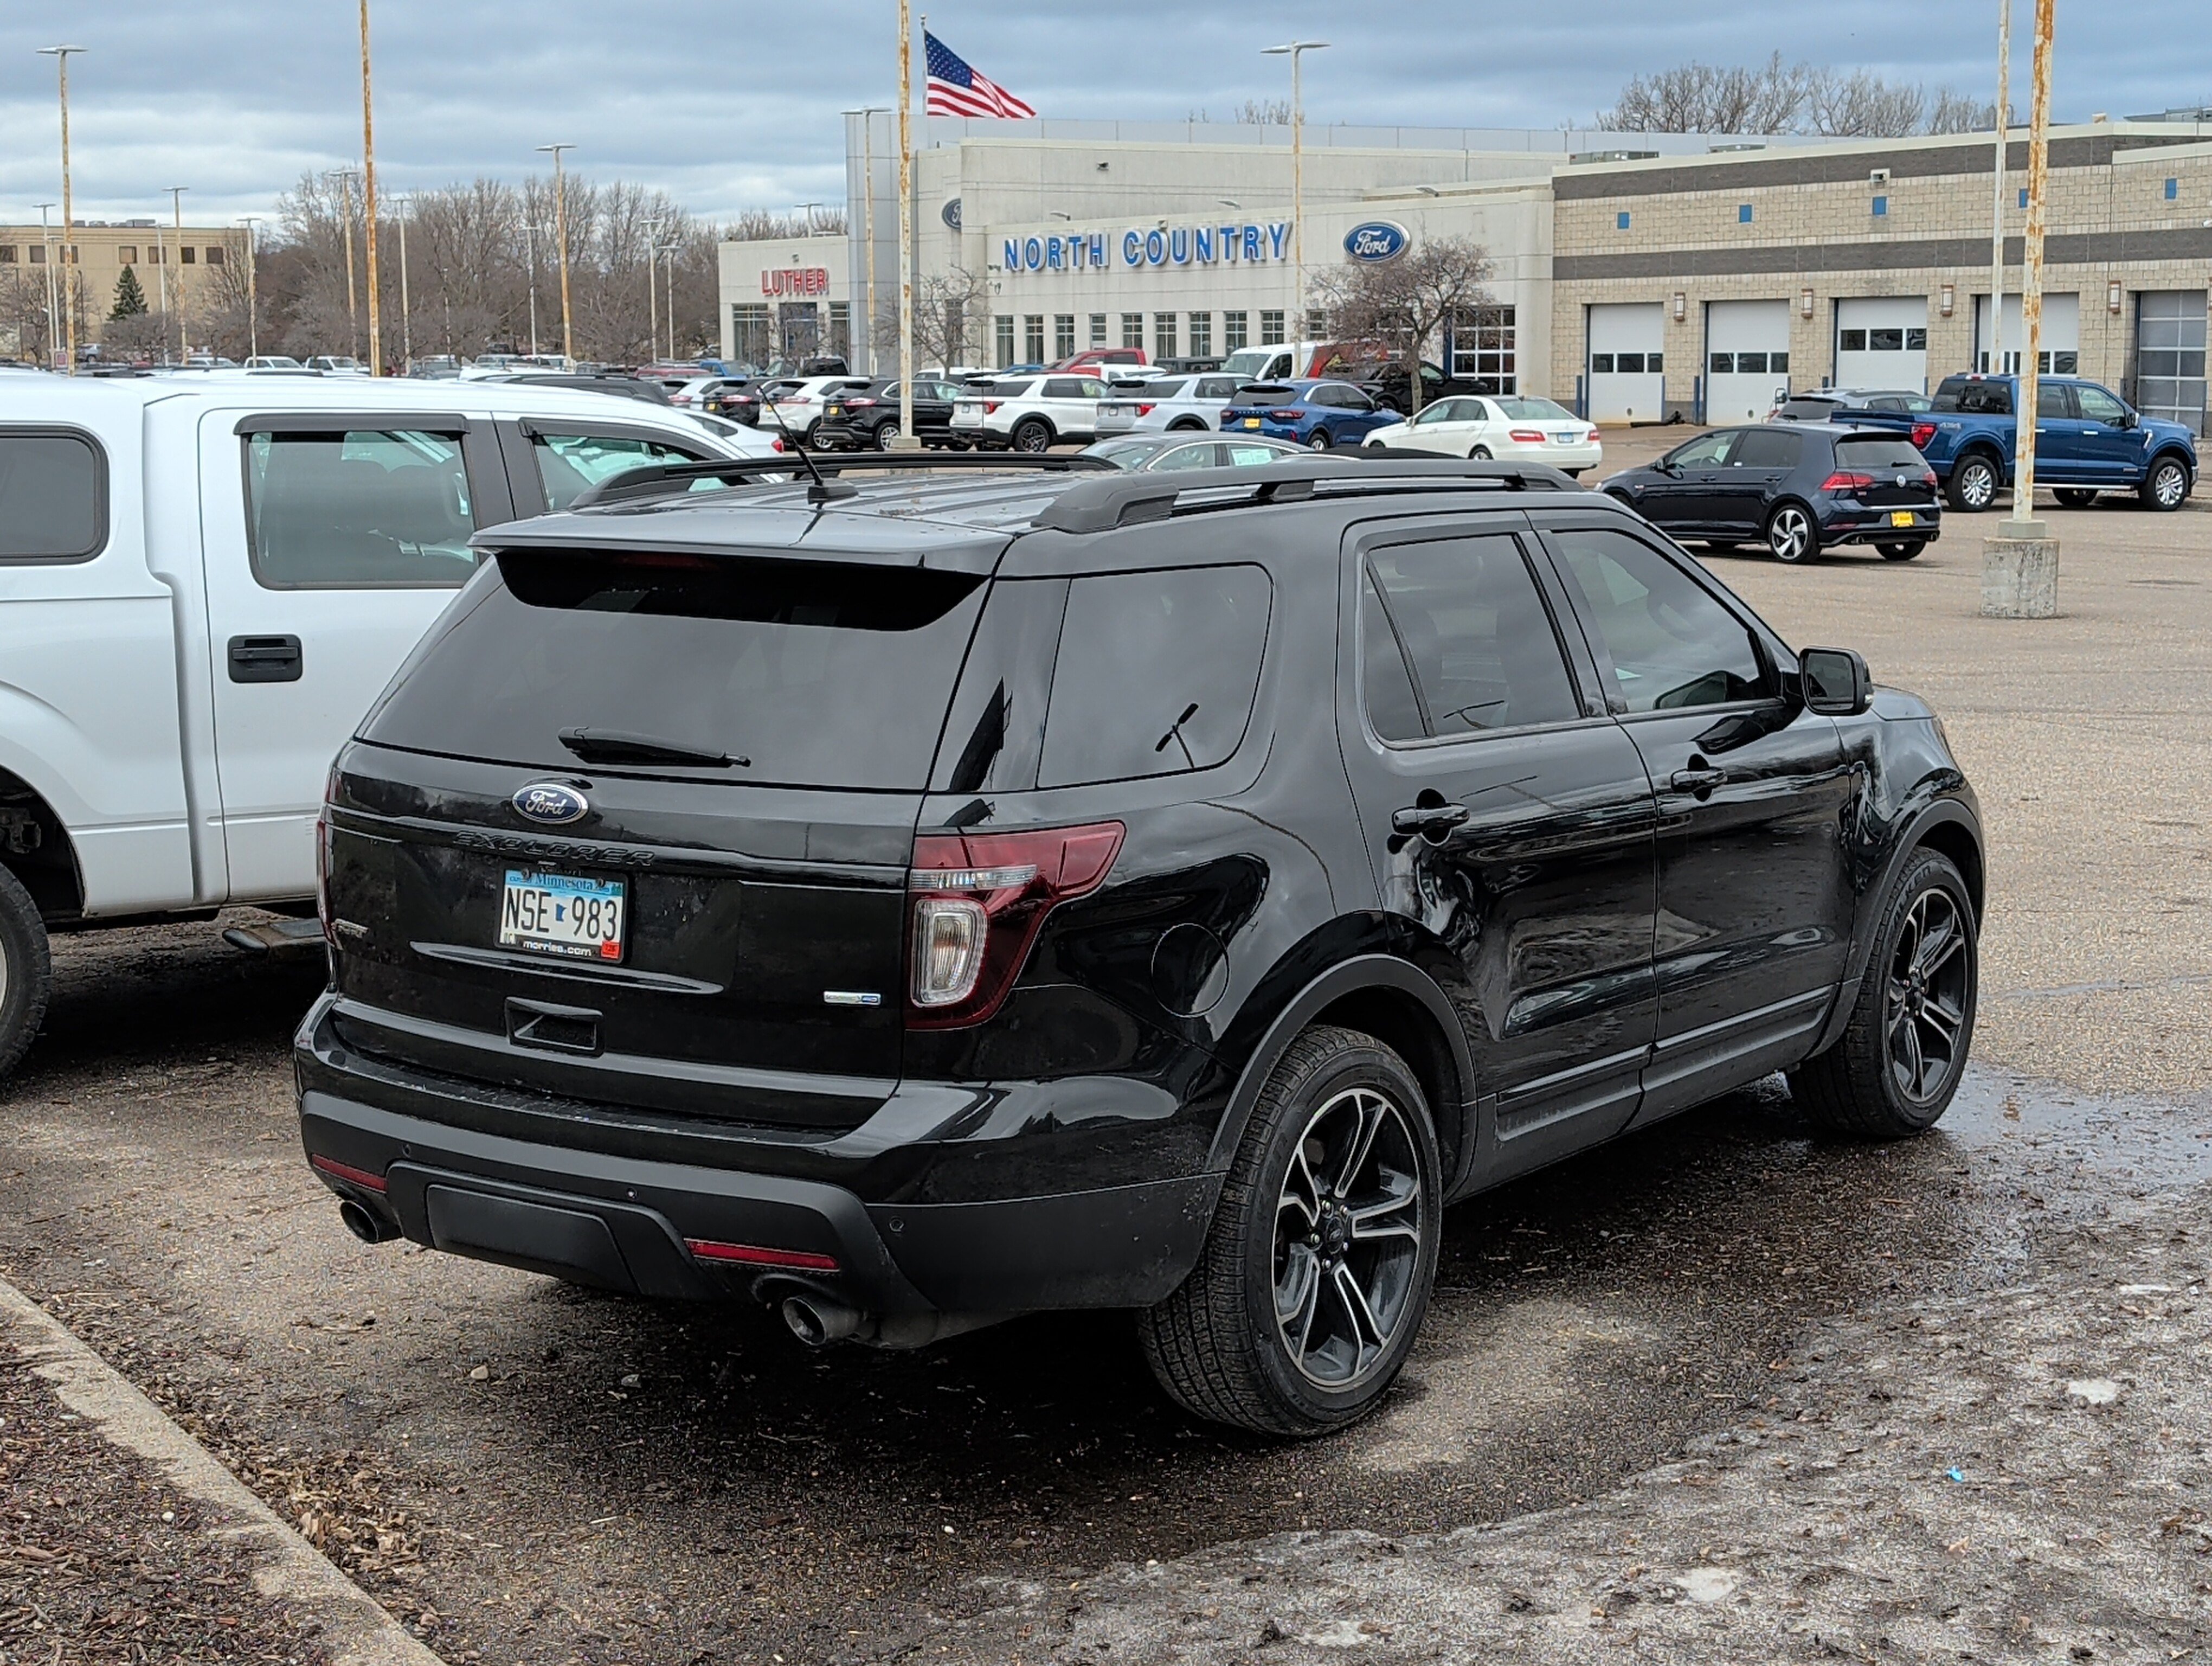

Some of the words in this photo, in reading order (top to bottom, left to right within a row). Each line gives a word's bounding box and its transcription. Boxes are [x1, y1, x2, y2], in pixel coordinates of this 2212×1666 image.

[1004, 233, 1110, 271] NORTH
[1122, 222, 1293, 266] COUNTRY
[1354, 229, 1391, 254] Ford
[761, 268, 829, 296] LUTHER
[525, 790, 568, 815] Ford
[453, 830, 655, 866] EXPLORER
[535, 873, 593, 890] Minnesota
[505, 887, 551, 933] NSE
[572, 896, 617, 941] 983
